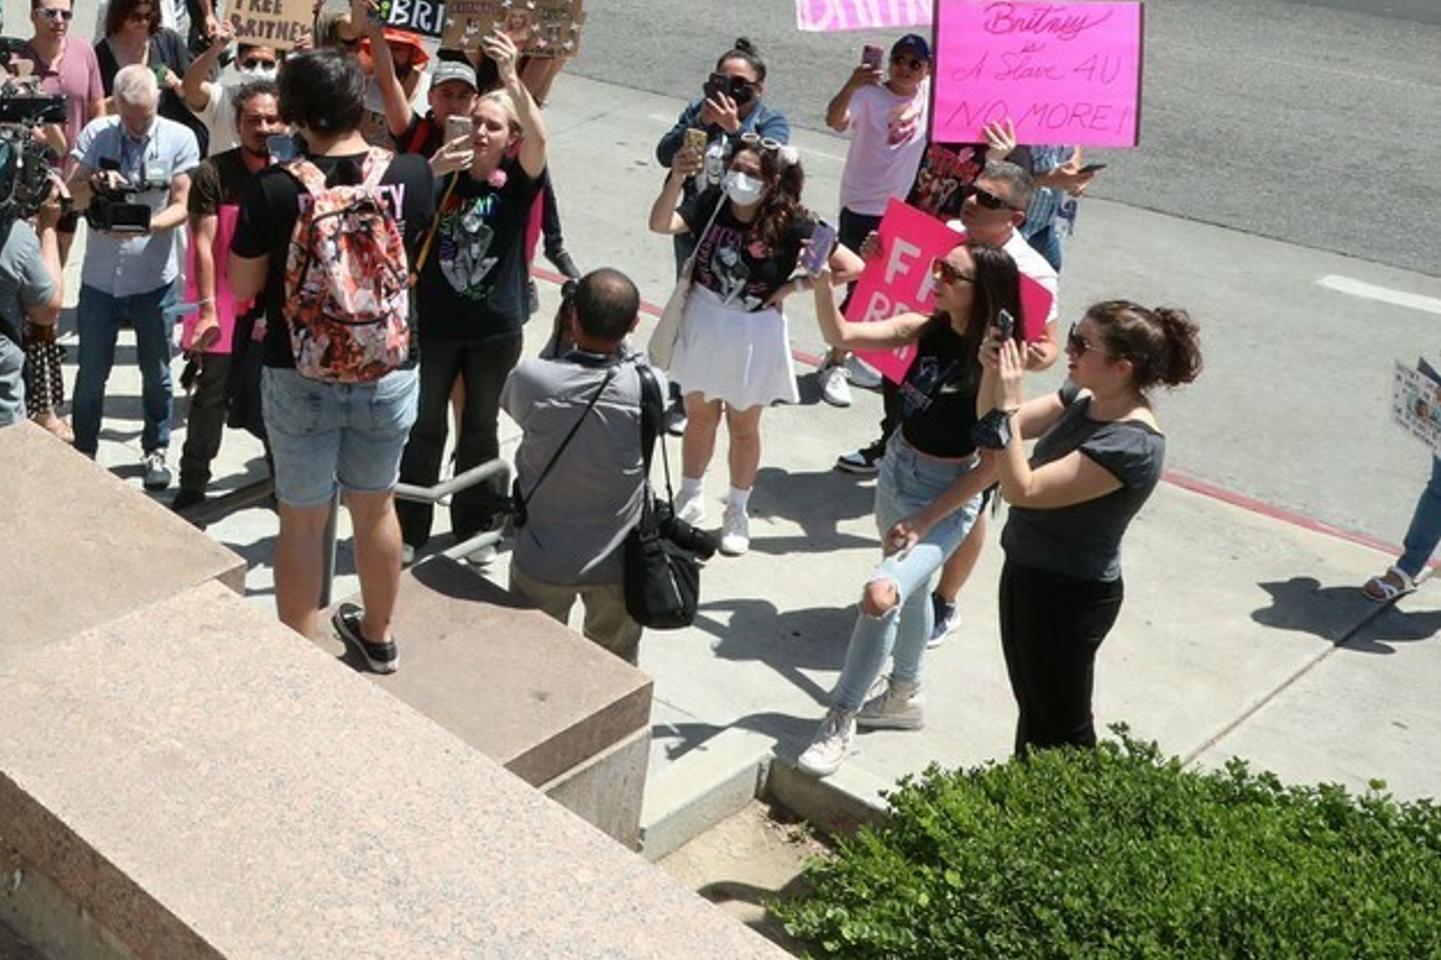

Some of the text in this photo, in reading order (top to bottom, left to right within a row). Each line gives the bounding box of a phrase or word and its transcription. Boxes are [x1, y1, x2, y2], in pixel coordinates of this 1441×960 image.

[984, 2, 1114, 40] Britney
[994, 52, 1065, 81] Slave
[945, 100, 1009, 127] NO
